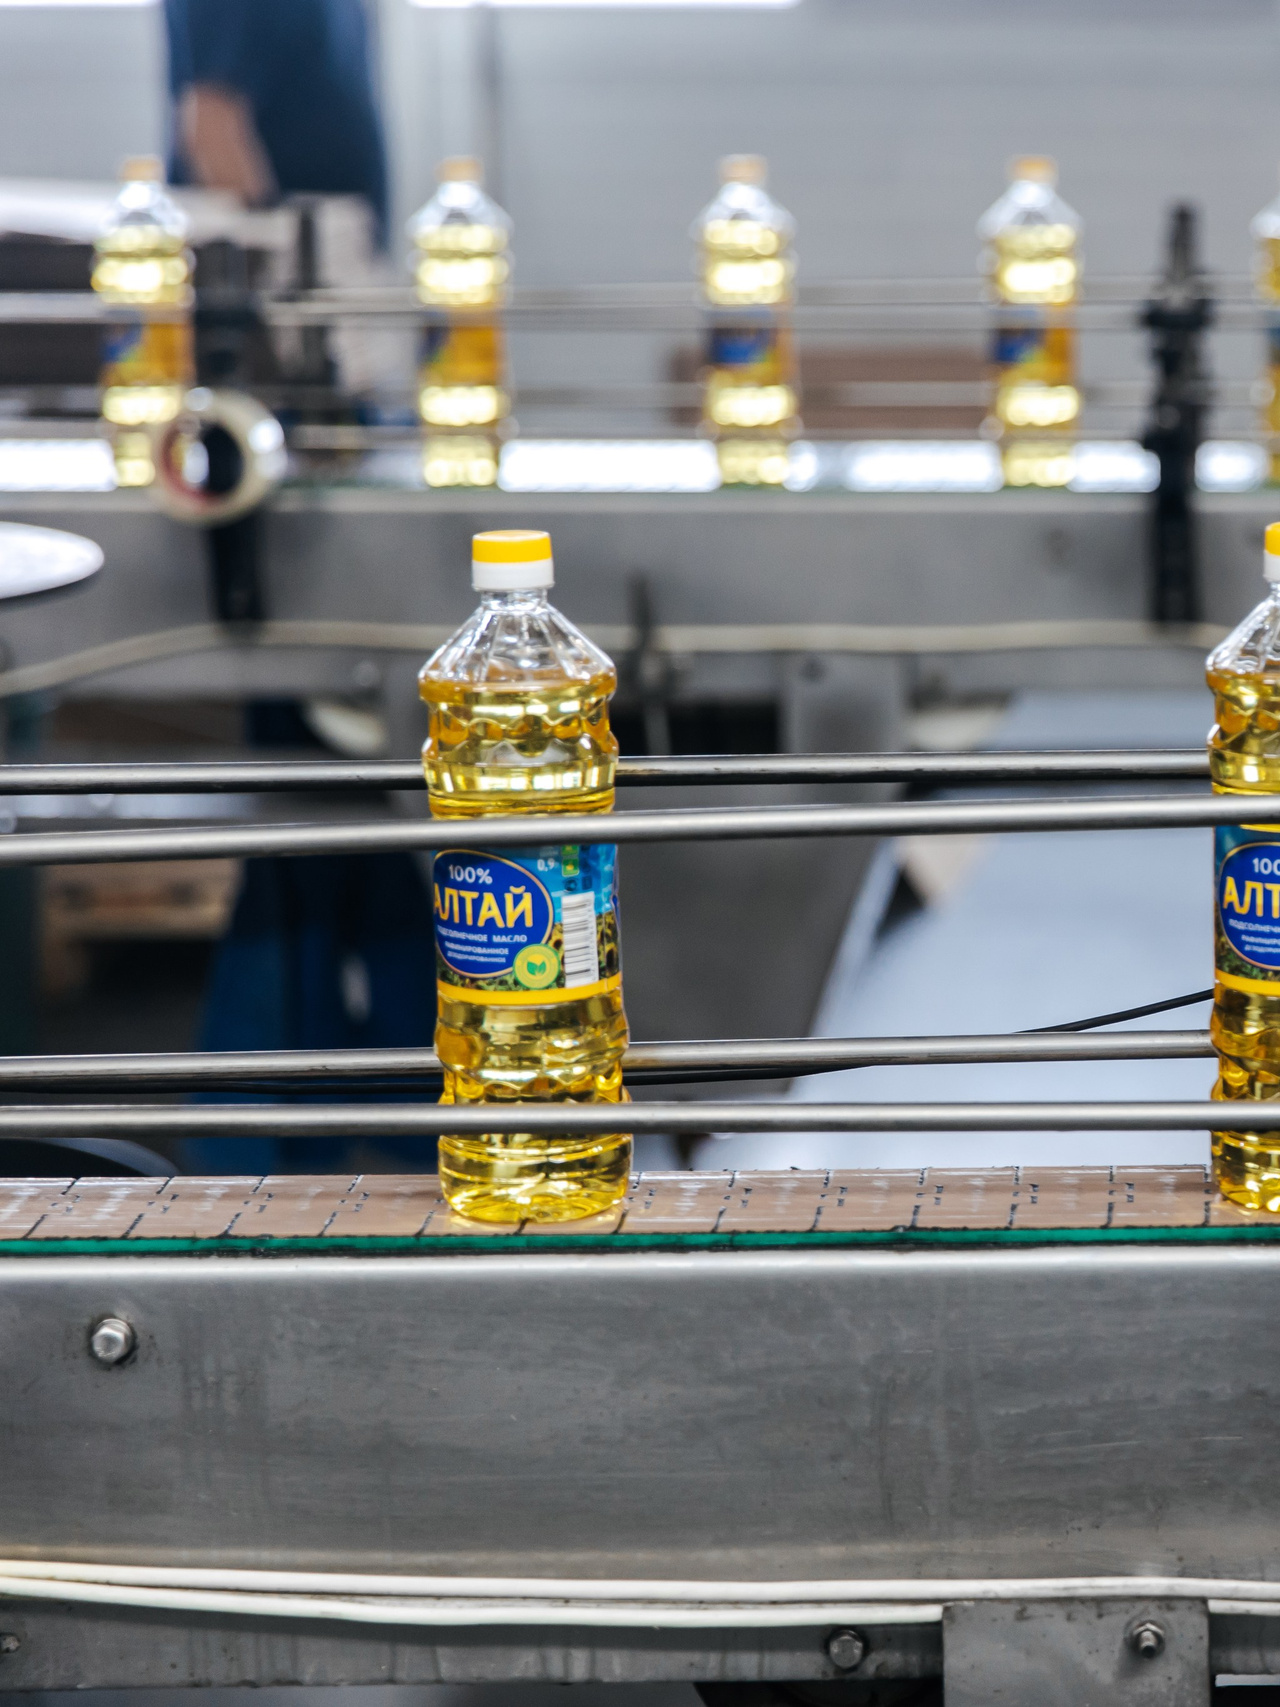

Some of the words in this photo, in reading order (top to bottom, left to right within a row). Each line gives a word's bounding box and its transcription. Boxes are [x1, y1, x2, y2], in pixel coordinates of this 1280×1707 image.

[449, 864, 493, 885] 100%
[433, 882, 534, 929] АЛТАЙ
[492, 934, 528, 943] МАСЛО
